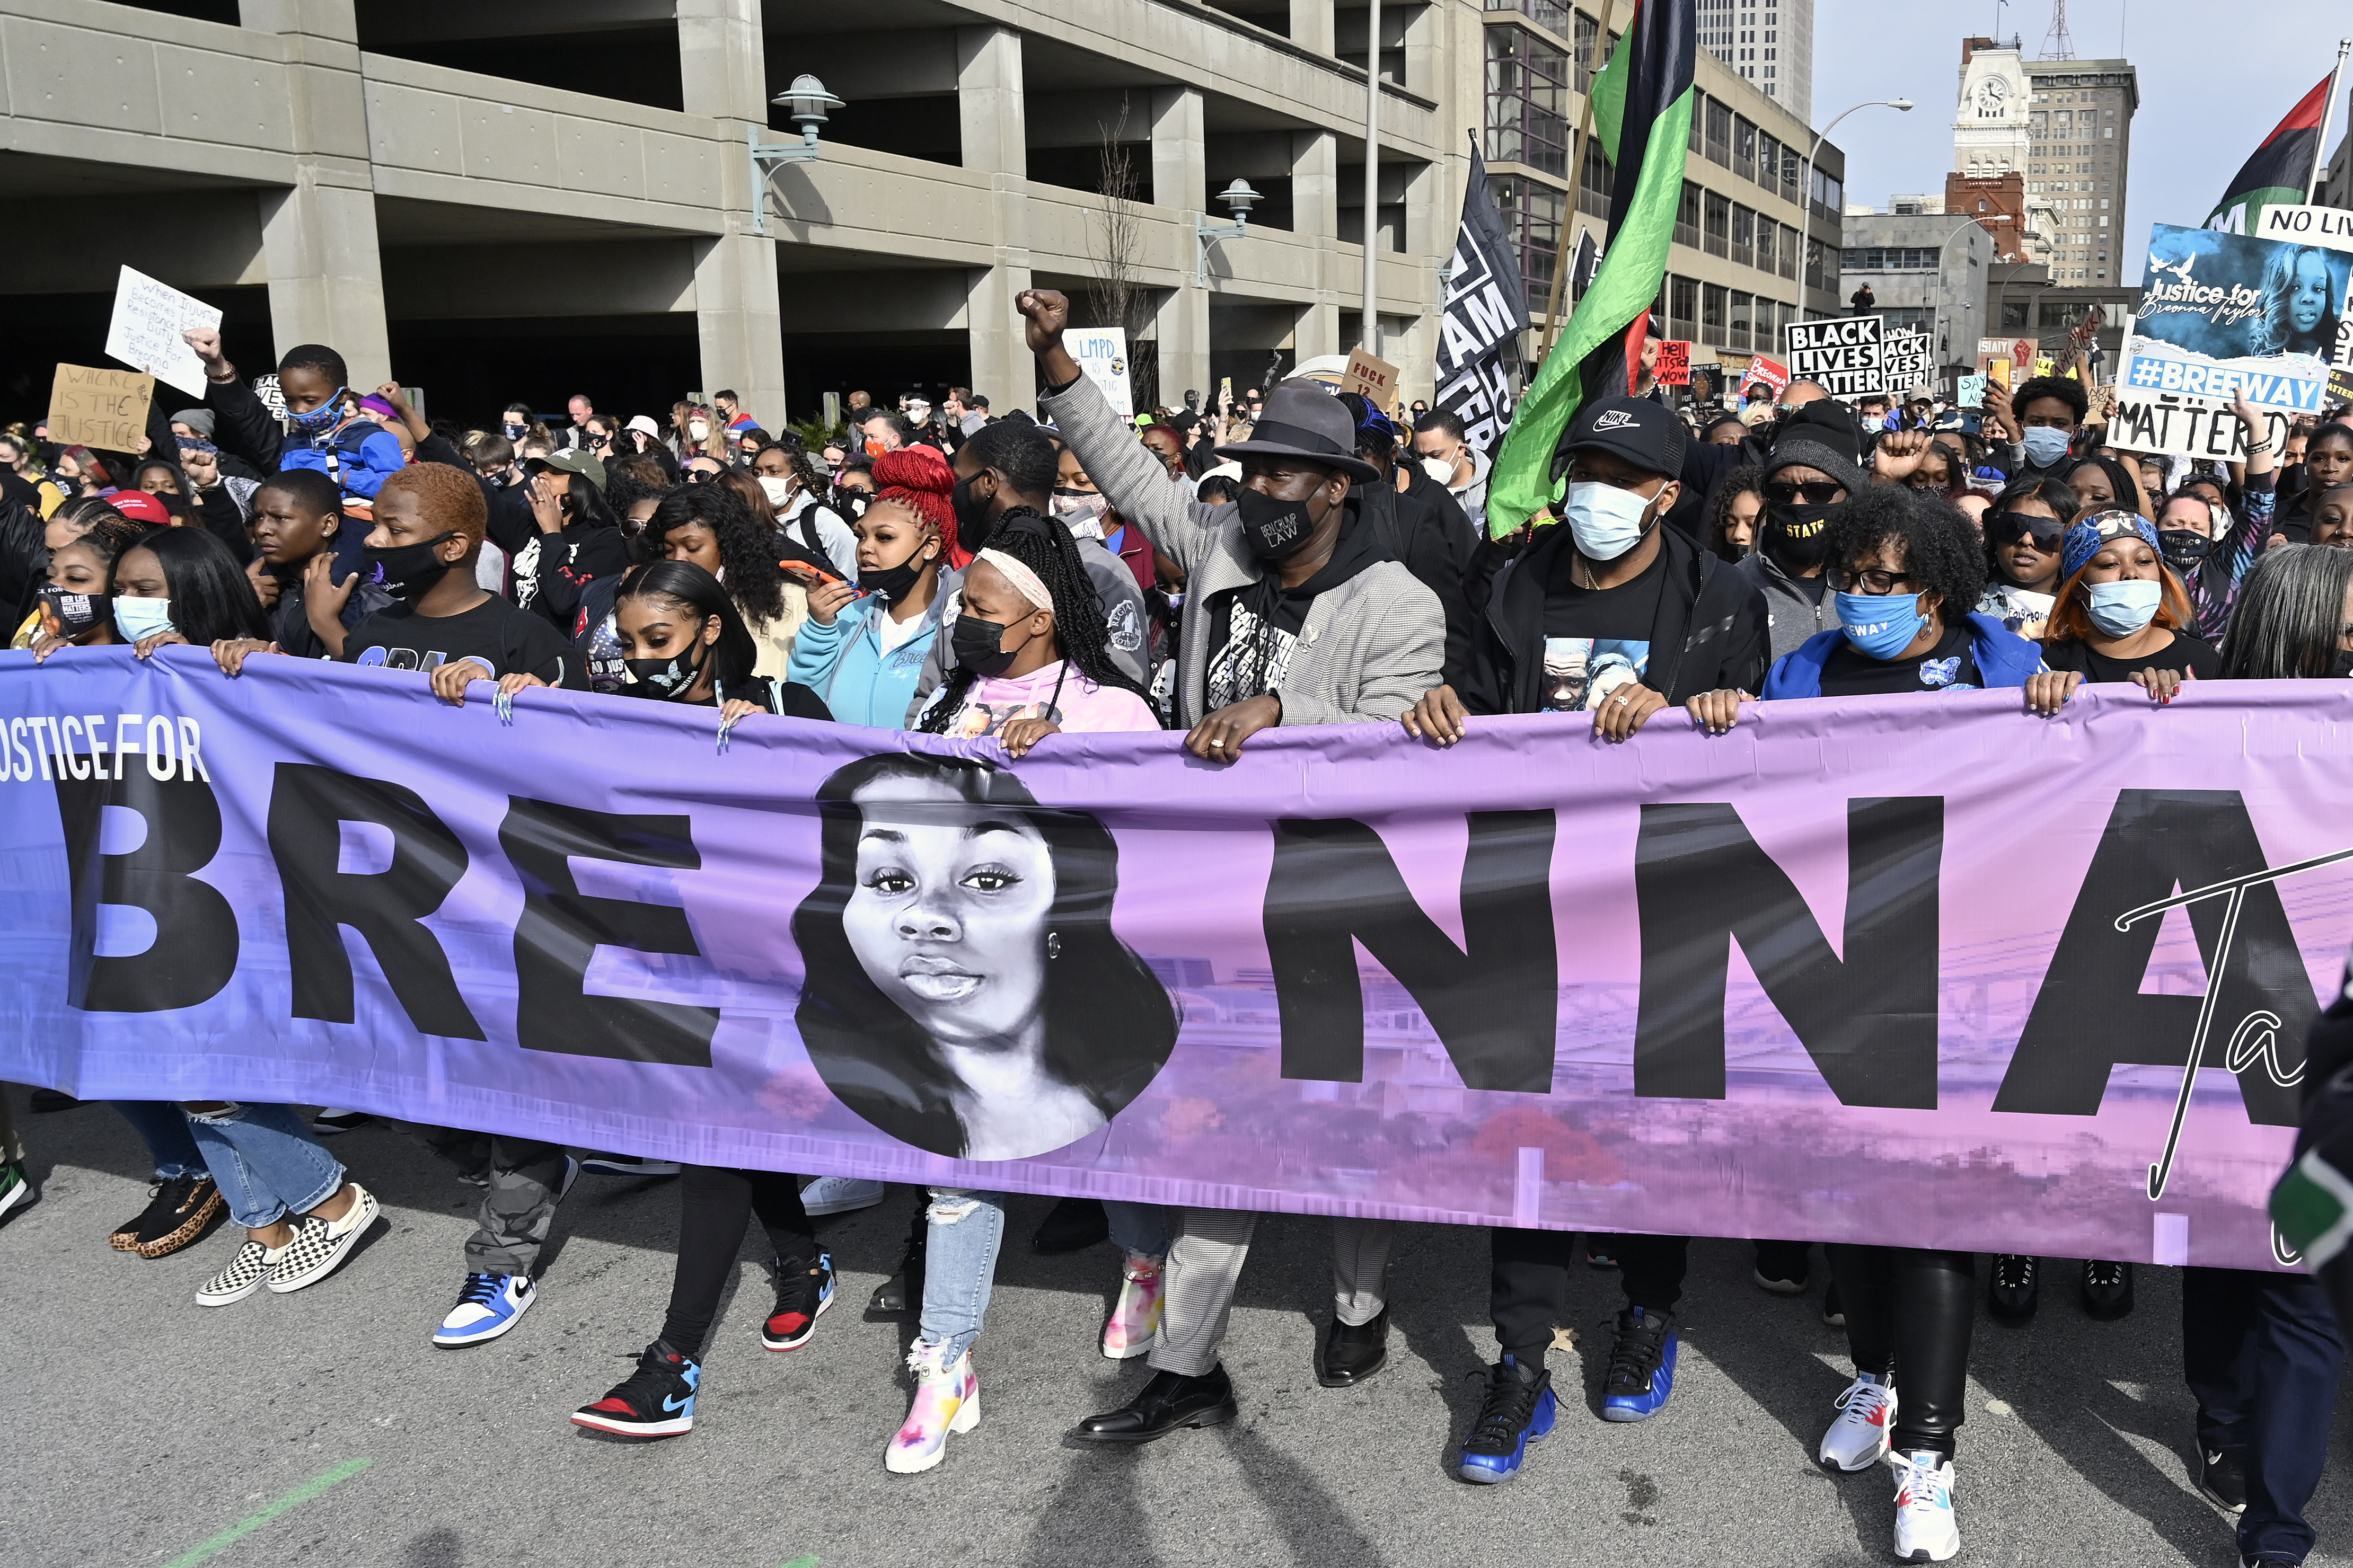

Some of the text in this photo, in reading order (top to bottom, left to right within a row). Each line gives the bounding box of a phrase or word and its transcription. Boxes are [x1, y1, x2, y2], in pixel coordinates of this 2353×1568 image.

[2270, 210, 2312, 232] NO
[141, 279, 175, 304] When
[2145, 278, 2262, 306] Justice for
[2137, 293, 2268, 325] Breonna Taylor
[1792, 321, 1878, 349] BLACK
[128, 342, 169, 369] Breonna
[1079, 339, 1115, 359] LMPD
[1662, 342, 1686, 357] Hell
[1884, 337, 1925, 357] ACK
[137, 358, 165, 378] Talor
[1092, 362, 1100, 374] IS
[1799, 346, 1873, 372] LIVES
[1884, 356, 1920, 374] VES
[256, 376, 280, 389] BLAC
[1354, 362, 1386, 387] FUCK
[1659, 370, 1688, 382] NOW
[1887, 372, 1924, 391] TTER
[2132, 360, 2318, 408] #BREEWAY
[1358, 384, 1371, 397] 12
[60, 391, 131, 416] IS THE
[1601, 410, 1632, 425] NIKE
[52, 415, 139, 449] JUSTICE
[1261, 513, 1296, 537] BEN CRUMP
[1267, 525, 1297, 547] LAW
[114, 714, 211, 782] FOR
